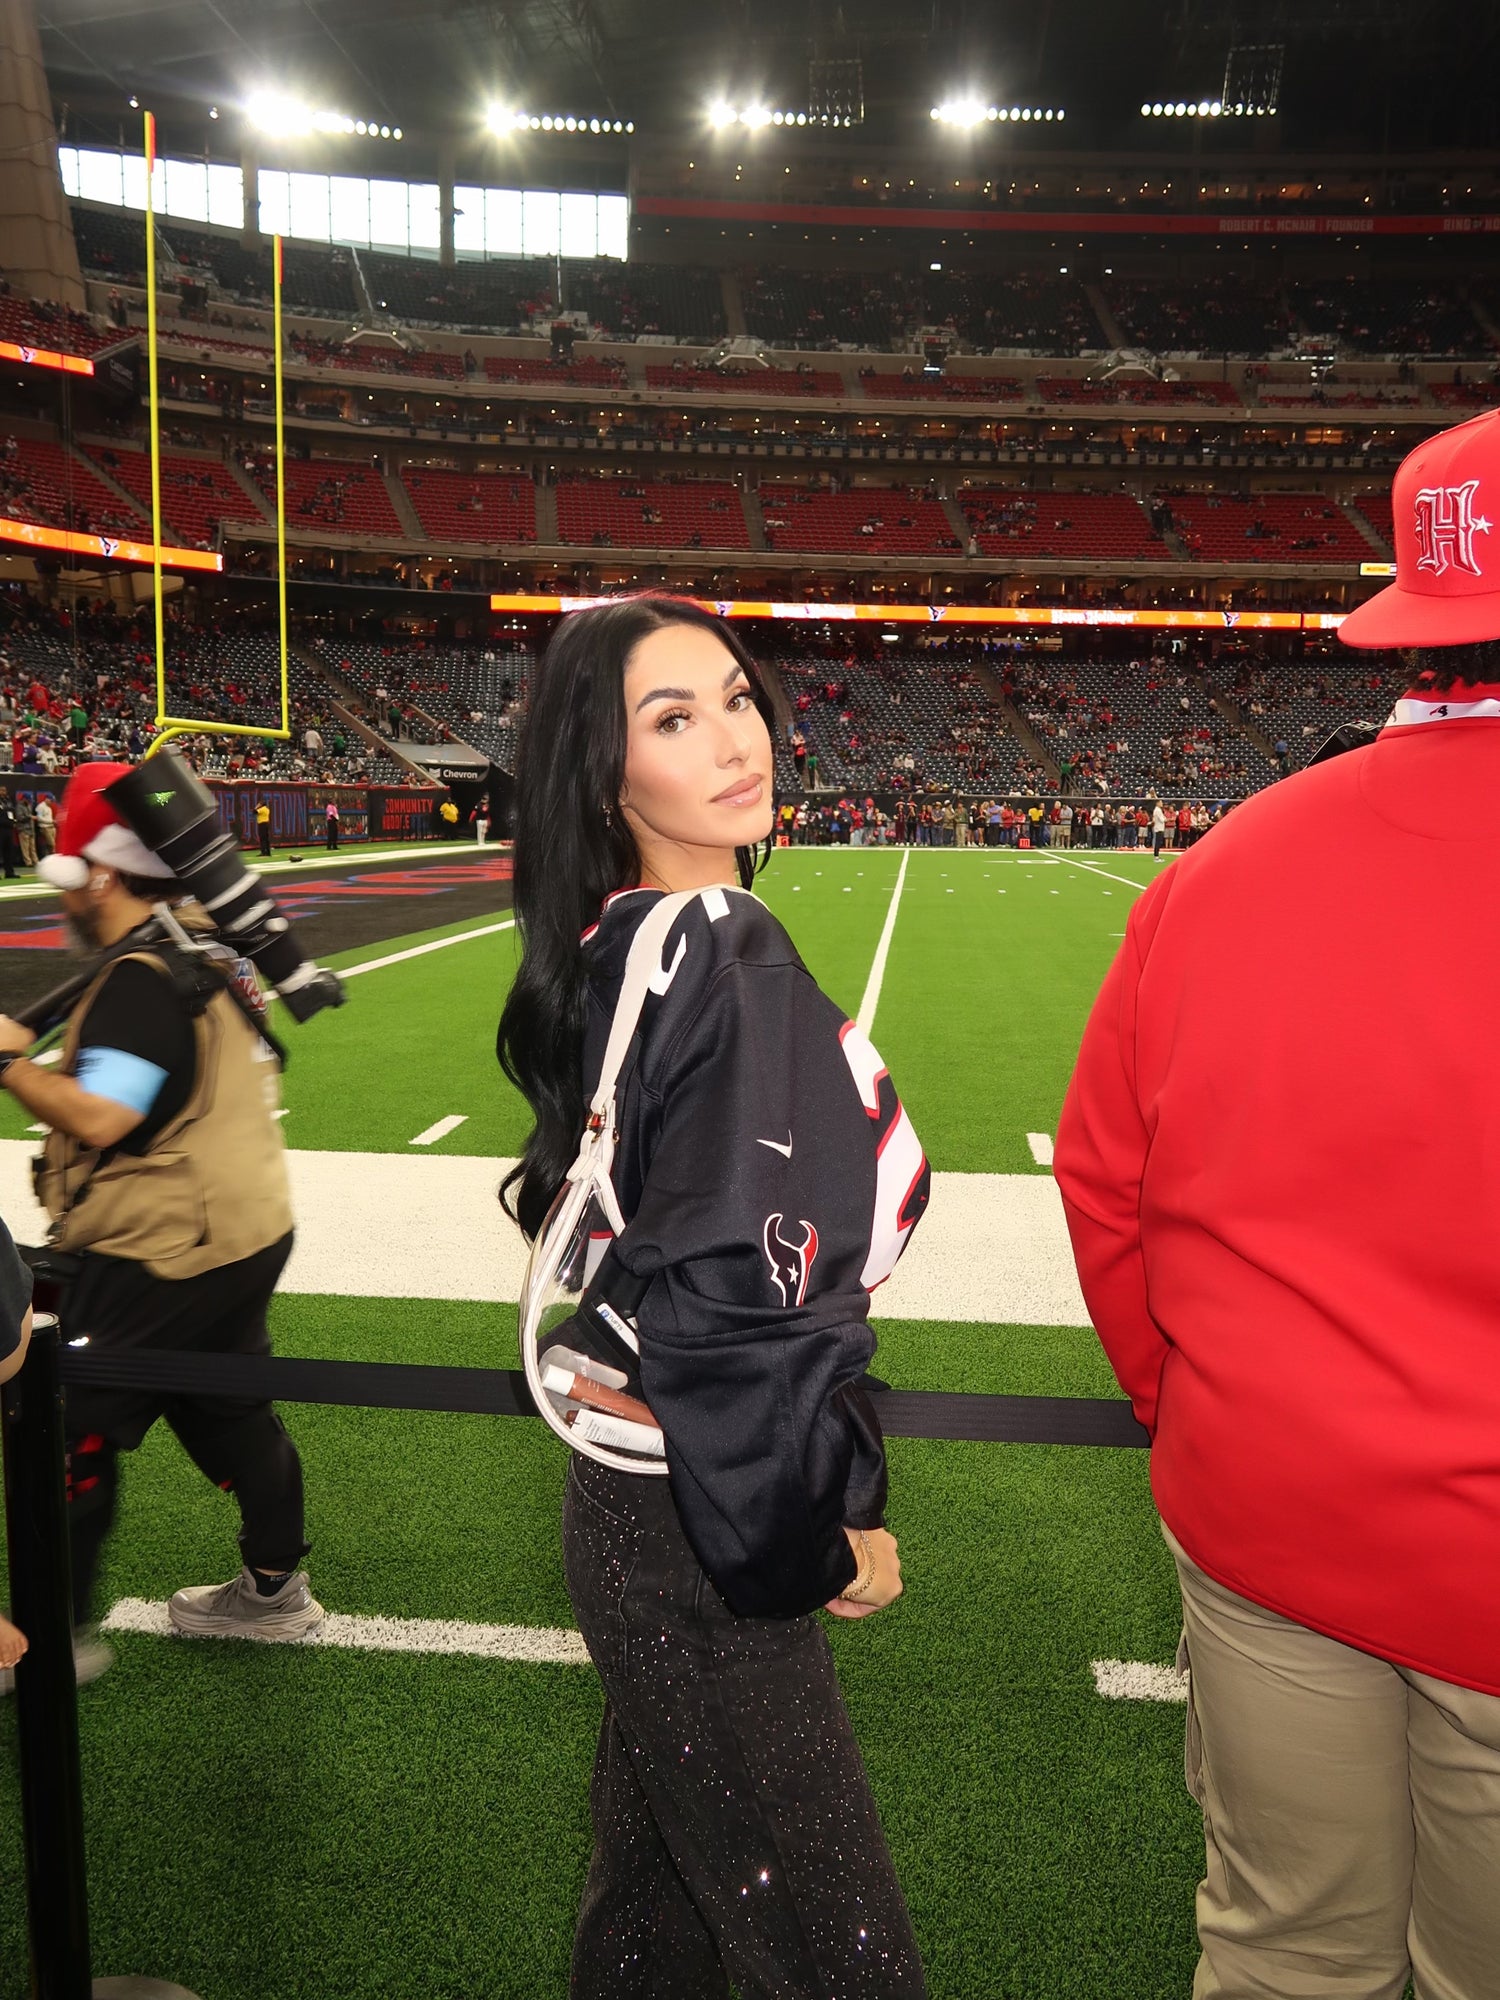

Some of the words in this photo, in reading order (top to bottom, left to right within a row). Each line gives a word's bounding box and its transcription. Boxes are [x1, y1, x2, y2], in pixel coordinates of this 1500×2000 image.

[1219, 219, 1260, 232] ROBERT
[1326, 219, 1374, 232] FOUNDER
[1414, 480, 1482, 576] H
[443, 769, 478, 779] Chevron
[384, 798, 434, 813] COMMUNITY
